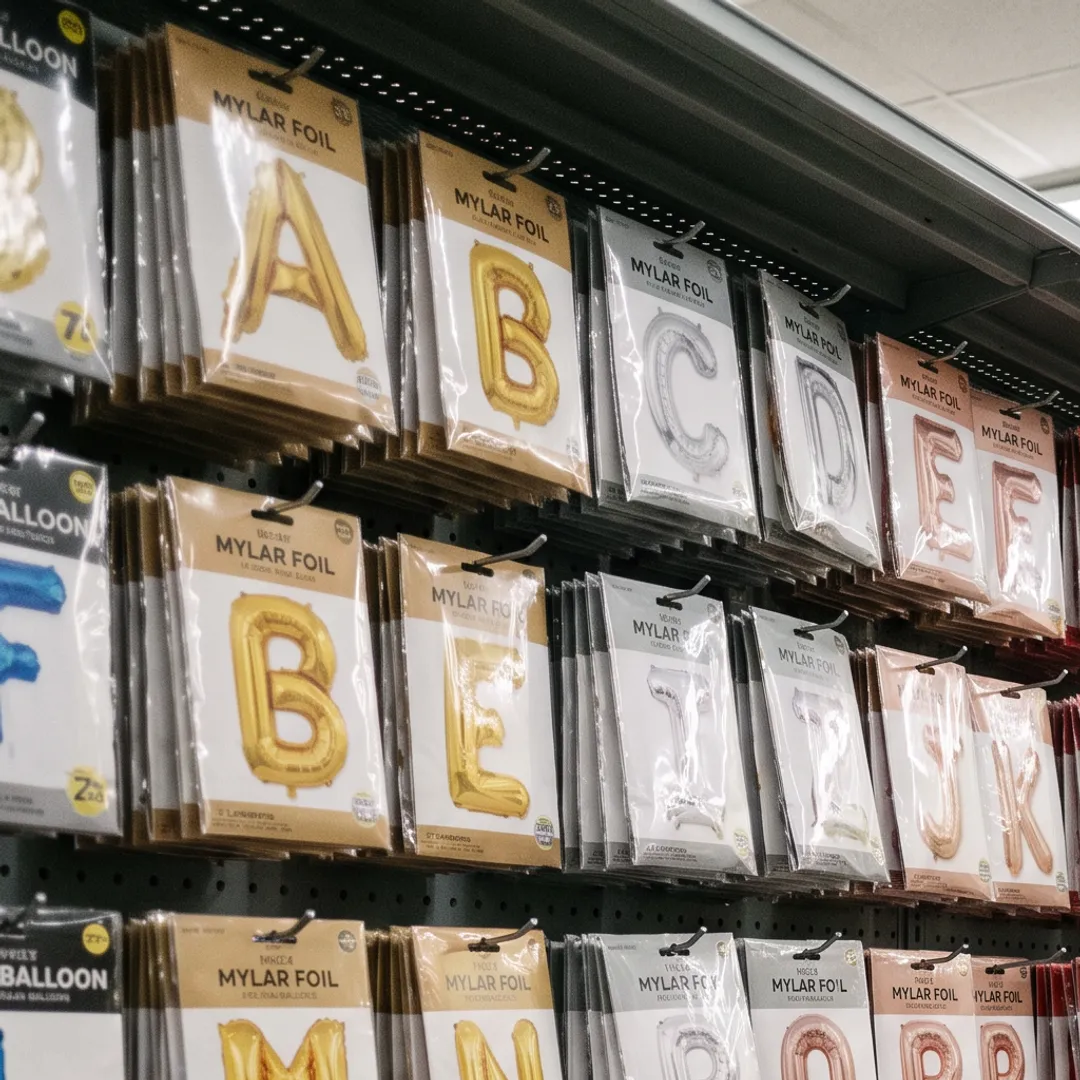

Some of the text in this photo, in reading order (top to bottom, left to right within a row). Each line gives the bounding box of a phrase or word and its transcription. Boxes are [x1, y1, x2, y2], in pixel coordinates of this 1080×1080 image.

[212, 89, 337, 153] MYLAR FOIL
[454, 188, 514, 228] MYLAR
[515, 215, 550, 244] FOIL
[220, 158, 369, 363] A
[630, 256, 682, 291] MYLAR
[684, 279, 714, 304] FOIL
[469, 241, 561, 431] B
[784, 316, 821, 346] MYLAR
[643, 307, 729, 484] C
[900, 374, 962, 412] MYLAR FOIL
[981, 424, 1044, 456] MYLAR FOIL
[913, 414, 974, 563] E
[992, 460, 1042, 592] F
[216, 534, 286, 565] MYLAR
[292, 553, 336, 576] FOIL
[432, 587, 487, 614] MYLAR
[632, 619, 680, 642] MYLAR
[778, 647, 840, 677] MYLAR FOIL
[229, 592, 347, 799] B
[443, 637, 530, 820] E
[0, 965, 108, 990] BALLOON
[219, 968, 338, 988] MYLAR FOIL
[446, 975, 531, 992] MYLAR FOIL
[639, 976, 690, 992] MYLAR
[772, 977, 815, 992] MYLAR
[892, 985, 958, 1002] MYLAR FOIL
[1004, 991, 1023, 1004] FOIL
